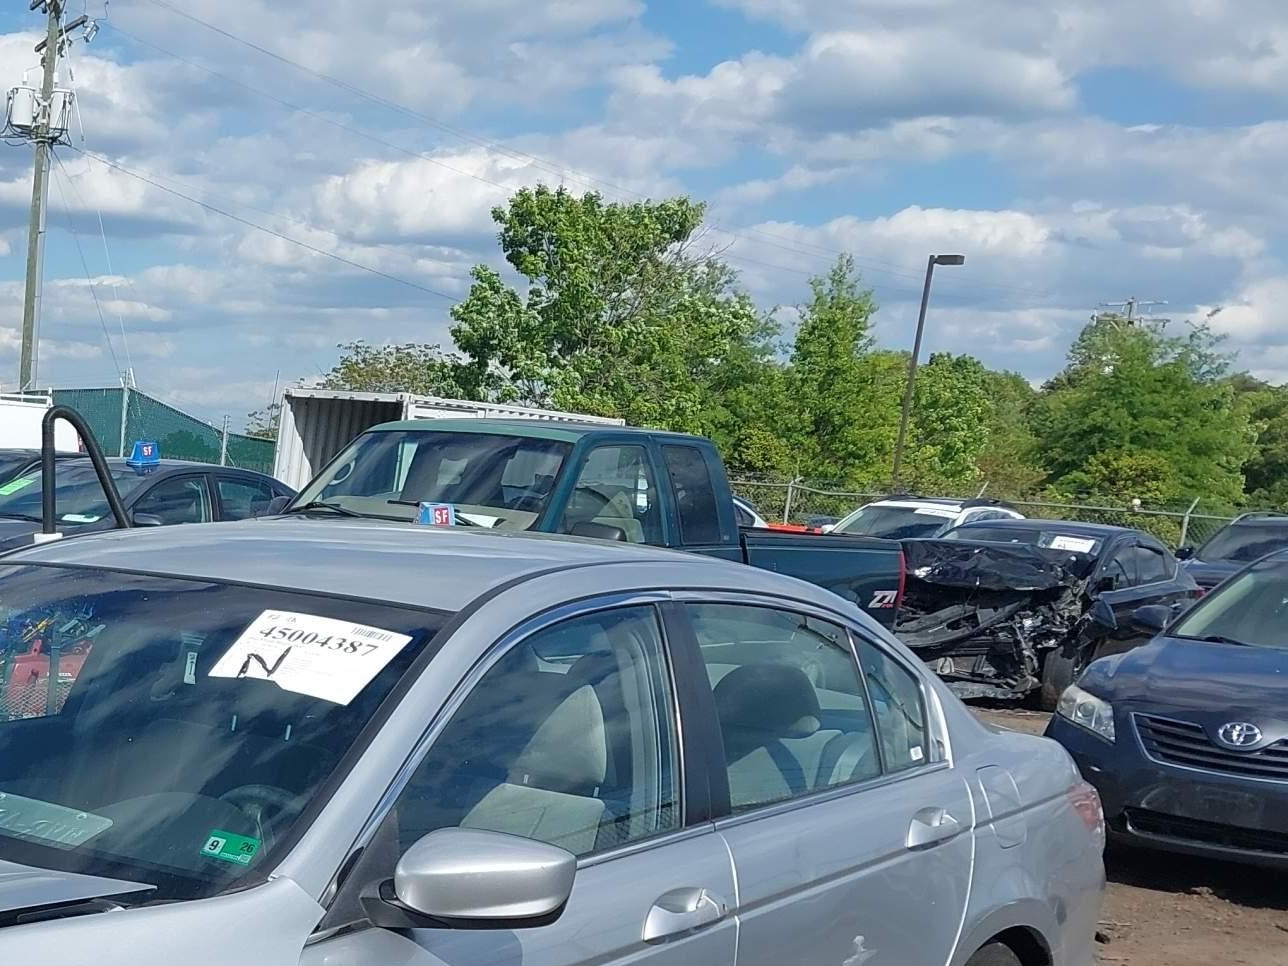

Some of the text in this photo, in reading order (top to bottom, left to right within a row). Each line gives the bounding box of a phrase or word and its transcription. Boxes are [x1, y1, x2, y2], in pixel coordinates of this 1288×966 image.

[143, 446, 152, 456] SF
[435, 509, 448, 524] SF
[868, 590, 898, 608] Z71
[259, 625, 379, 656] 45004387
[237, 646, 292, 679] N
[209, 839, 255, 853] 9 26
